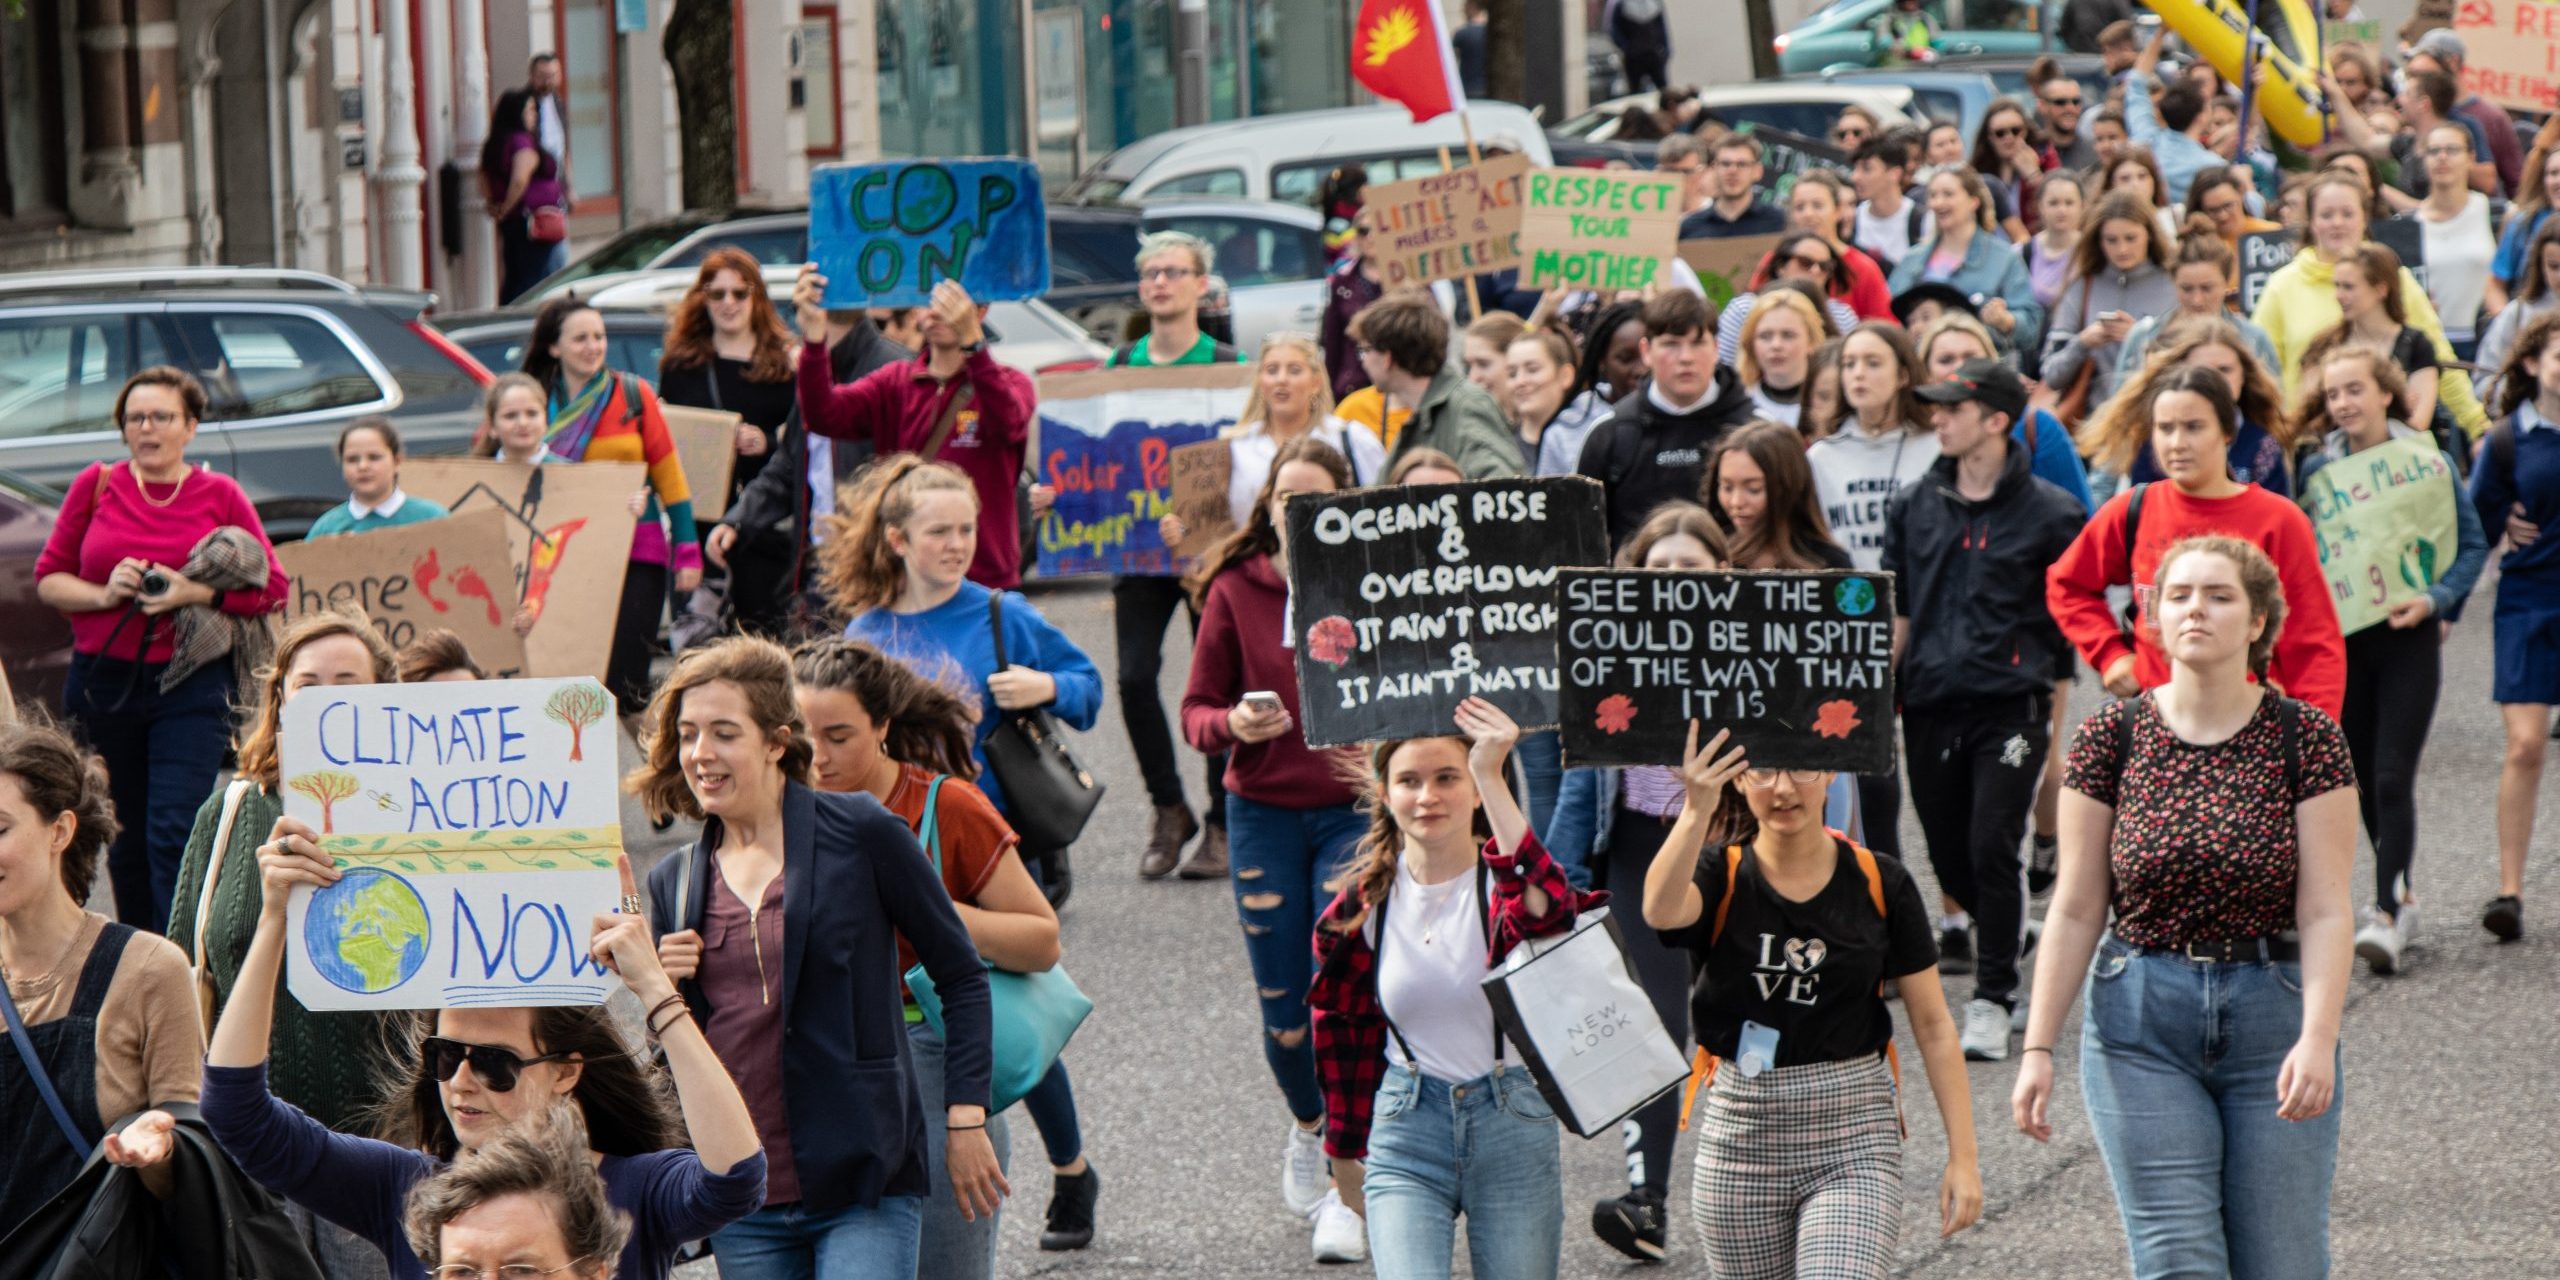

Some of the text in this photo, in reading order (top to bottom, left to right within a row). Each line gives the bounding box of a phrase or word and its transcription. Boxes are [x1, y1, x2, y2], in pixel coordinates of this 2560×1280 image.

[1375, 174, 1523, 233] LITTLE ACT
[1530, 173, 1675, 212] RESPECT
[1569, 213, 1632, 239] YOUR
[857, 218, 974, 294] ON
[1532, 248, 1660, 287] MOTHER
[1047, 447, 1124, 495] Solar
[2370, 454, 2446, 493] Maths
[1314, 490, 1547, 545] OCEANS RISE
[1438, 525, 1469, 562] &
[1360, 564, 1558, 603] OVERFLOW
[1567, 578, 1823, 613] SEE HOW THE
[1355, 617, 1383, 652] IT
[1389, 606, 1474, 642] AIN'T
[1569, 618, 1888, 655] COULD BE IN SPITE
[1451, 641, 1480, 674] &
[1571, 656, 1889, 689] OF THE WAY THAT
[1337, 676, 1370, 709] IT
[1682, 688, 1766, 720] IT IS
[319, 701, 527, 766] CLIMATE
[408, 774, 568, 832] ACTION
[1566, 1001, 1617, 1039] NEW
[1571, 1013, 1632, 1057] LOOK
